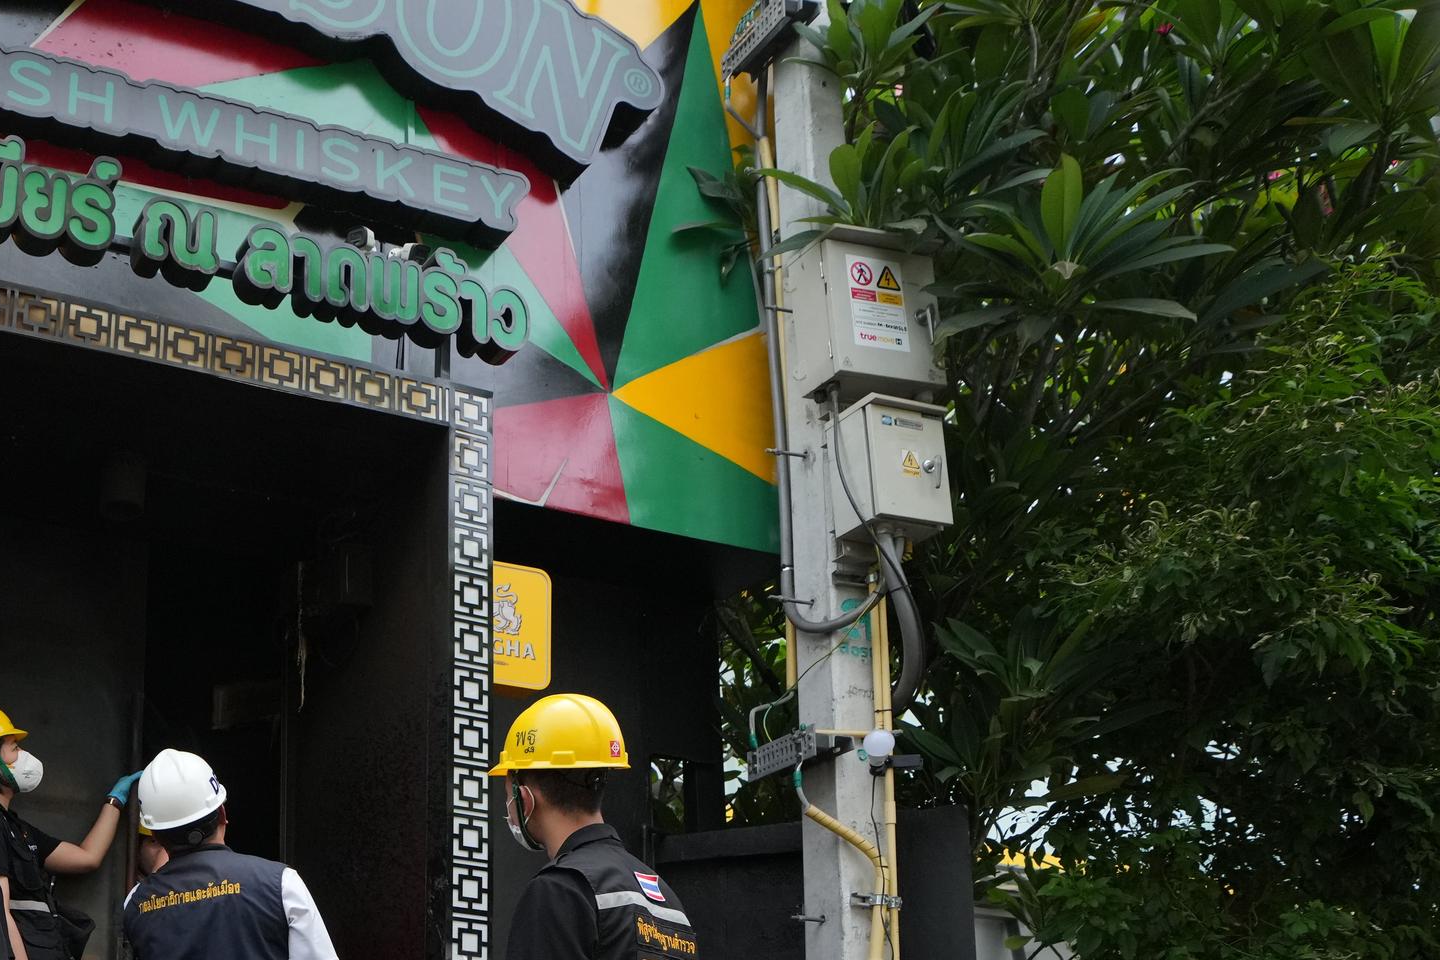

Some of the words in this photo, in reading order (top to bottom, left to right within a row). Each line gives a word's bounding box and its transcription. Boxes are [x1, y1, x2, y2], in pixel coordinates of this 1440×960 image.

[289, 0, 630, 153] ON
[159, 94, 515, 220] WHISKEY
[142, 200, 220, 274] ณ
[247, 223, 531, 350] ลาดพร้าว
